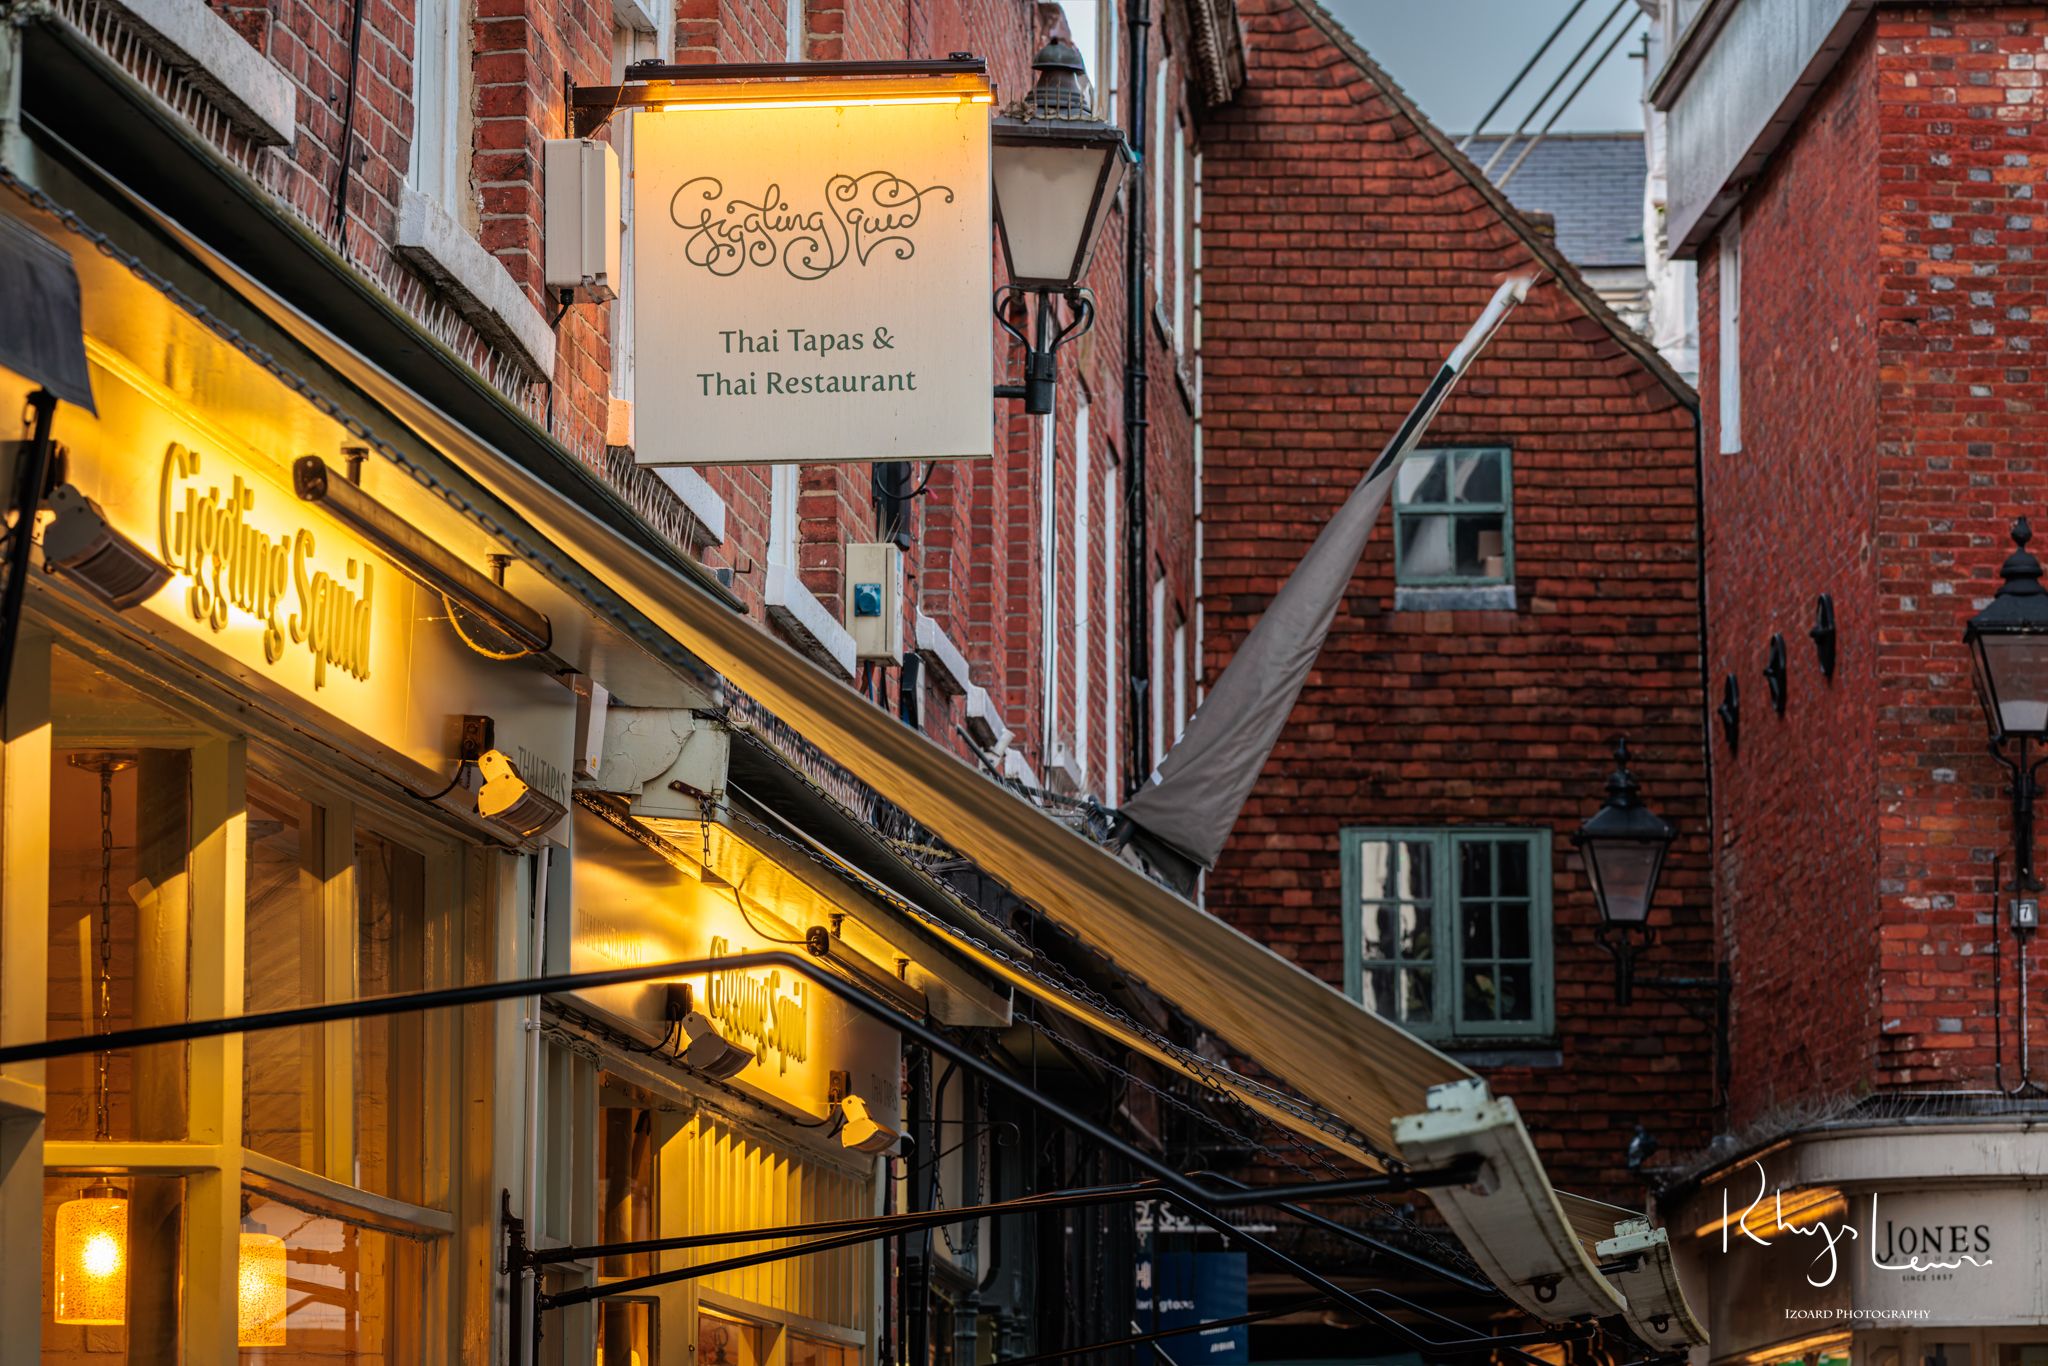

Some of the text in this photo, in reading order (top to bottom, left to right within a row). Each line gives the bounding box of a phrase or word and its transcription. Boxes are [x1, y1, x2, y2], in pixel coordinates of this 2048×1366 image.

[718, 326, 896, 358] Thai Tapas &
[696, 369, 918, 397] Thai Restaurant
[159, 441, 374, 691] Giggling Squid
[1902, 1274, 1926, 1282] SINCE
